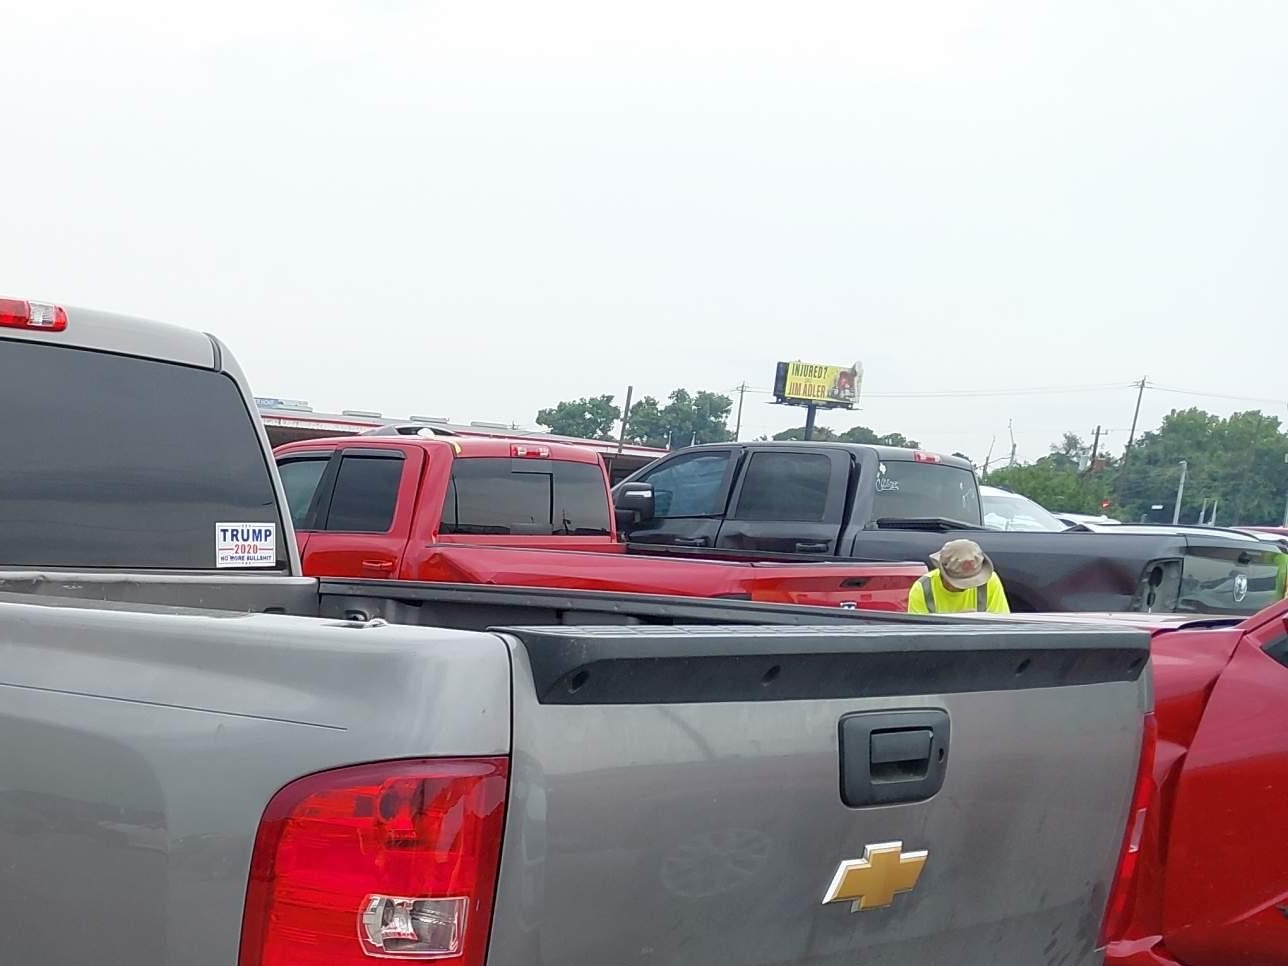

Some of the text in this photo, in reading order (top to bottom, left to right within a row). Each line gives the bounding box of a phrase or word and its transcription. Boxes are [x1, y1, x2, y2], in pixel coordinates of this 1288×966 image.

[791, 363, 828, 379] INJURED?
[788, 382, 826, 398] JIM ADLER
[220, 529, 272, 542] TRUMP
[234, 544, 258, 554] 2020
